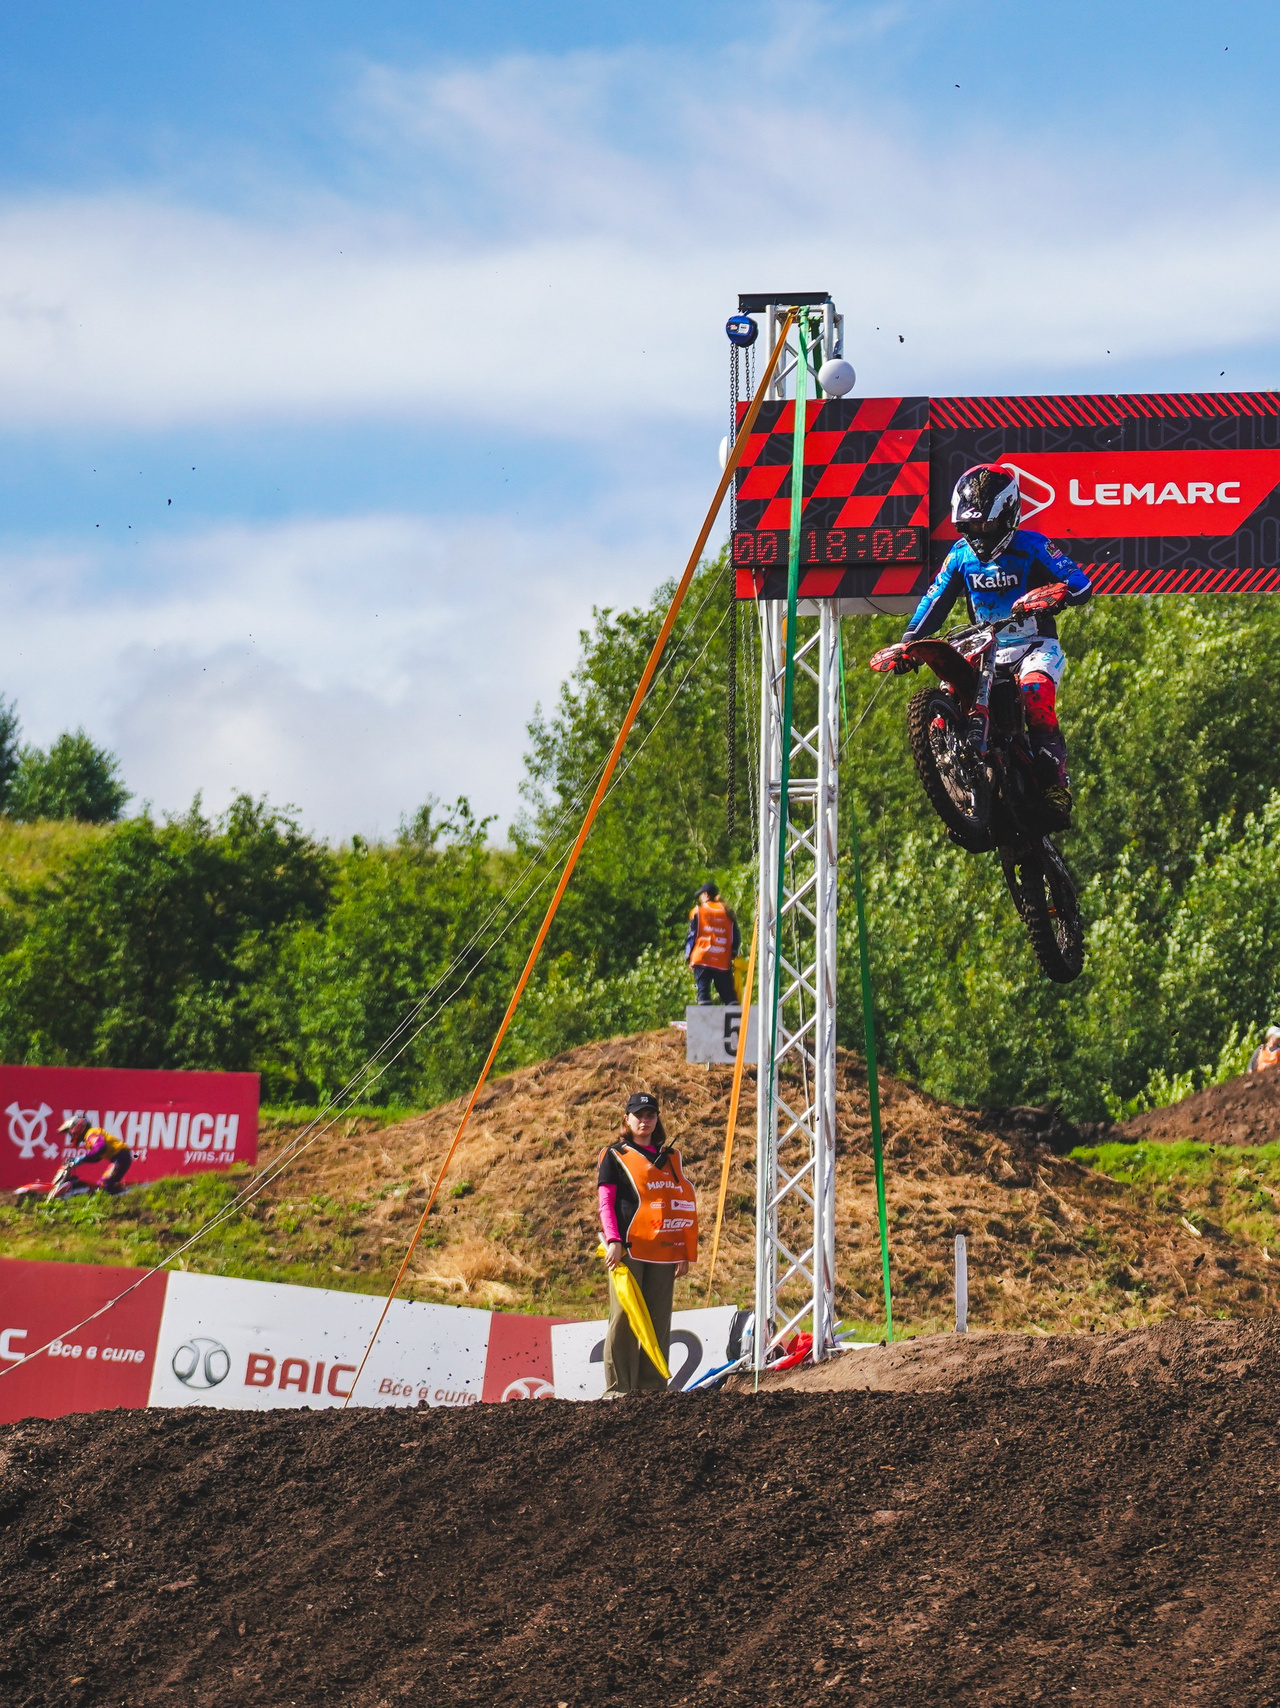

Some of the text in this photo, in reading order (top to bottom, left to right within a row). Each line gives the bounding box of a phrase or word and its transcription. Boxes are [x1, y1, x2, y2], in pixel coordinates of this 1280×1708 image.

[1069, 478, 1241, 505] LEMARC
[969, 571, 1018, 588] Kalin
[724, 1012, 743, 1057] 5
[184, 1150, 235, 1165] yms.ru
[663, 1218, 694, 1228] RGP
[48, 1340, 146, 1363] Все в силе
[244, 1352, 357, 1398] BAIC
[379, 1378, 478, 1404] Все в силе
